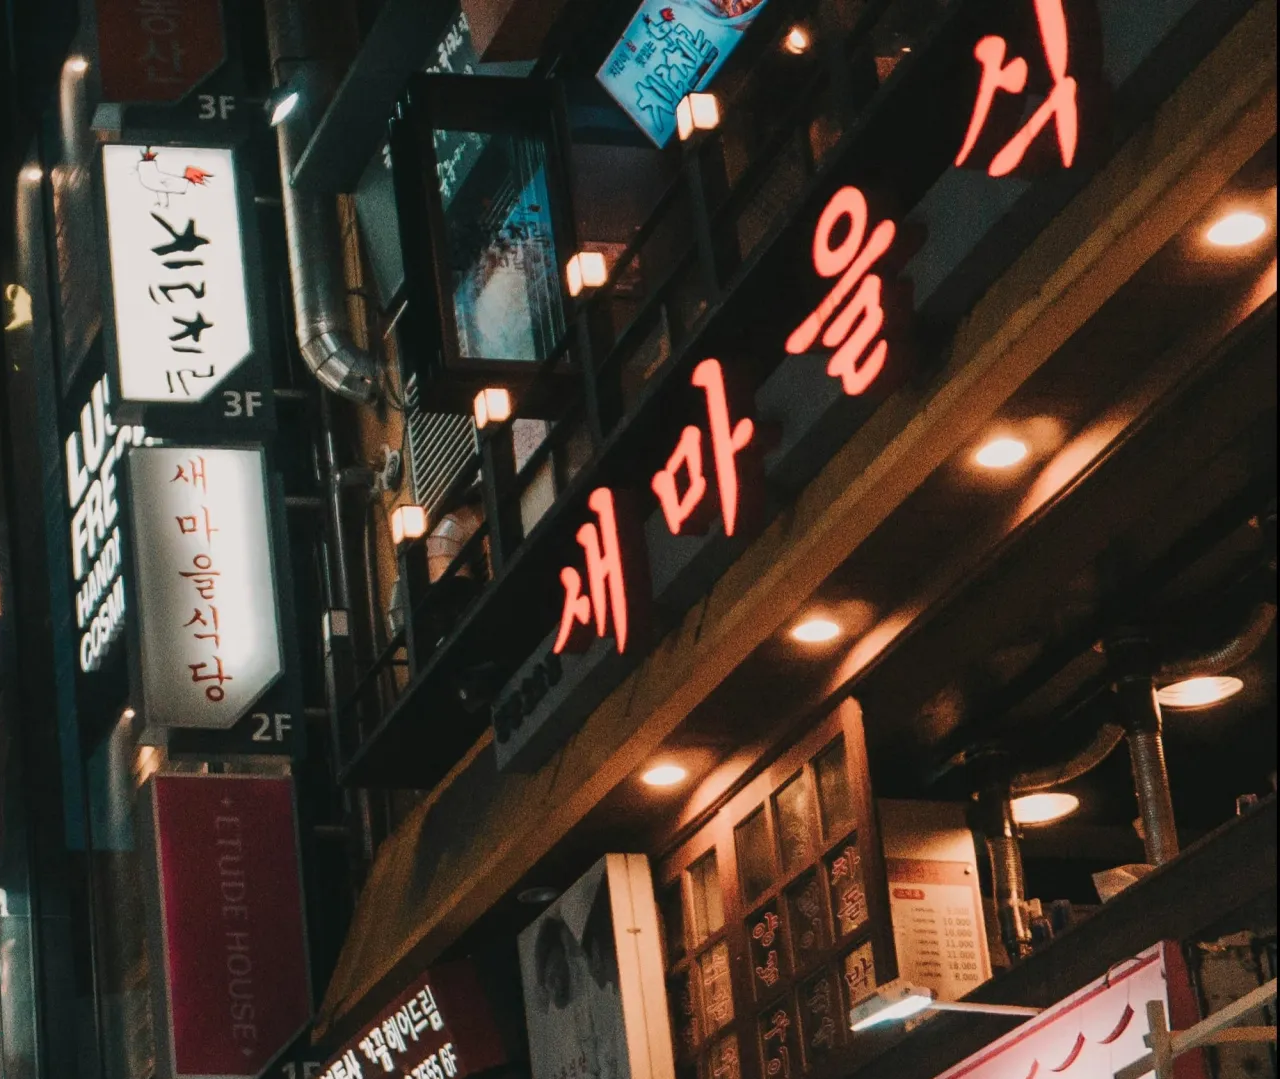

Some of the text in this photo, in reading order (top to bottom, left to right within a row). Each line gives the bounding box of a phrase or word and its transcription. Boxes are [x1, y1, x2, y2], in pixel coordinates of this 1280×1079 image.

[198, 95, 236, 119] 3F
[223, 390, 263, 418] 3F
[169, 455, 234, 702] 새마을식당
[251, 713, 293, 741] 2F
